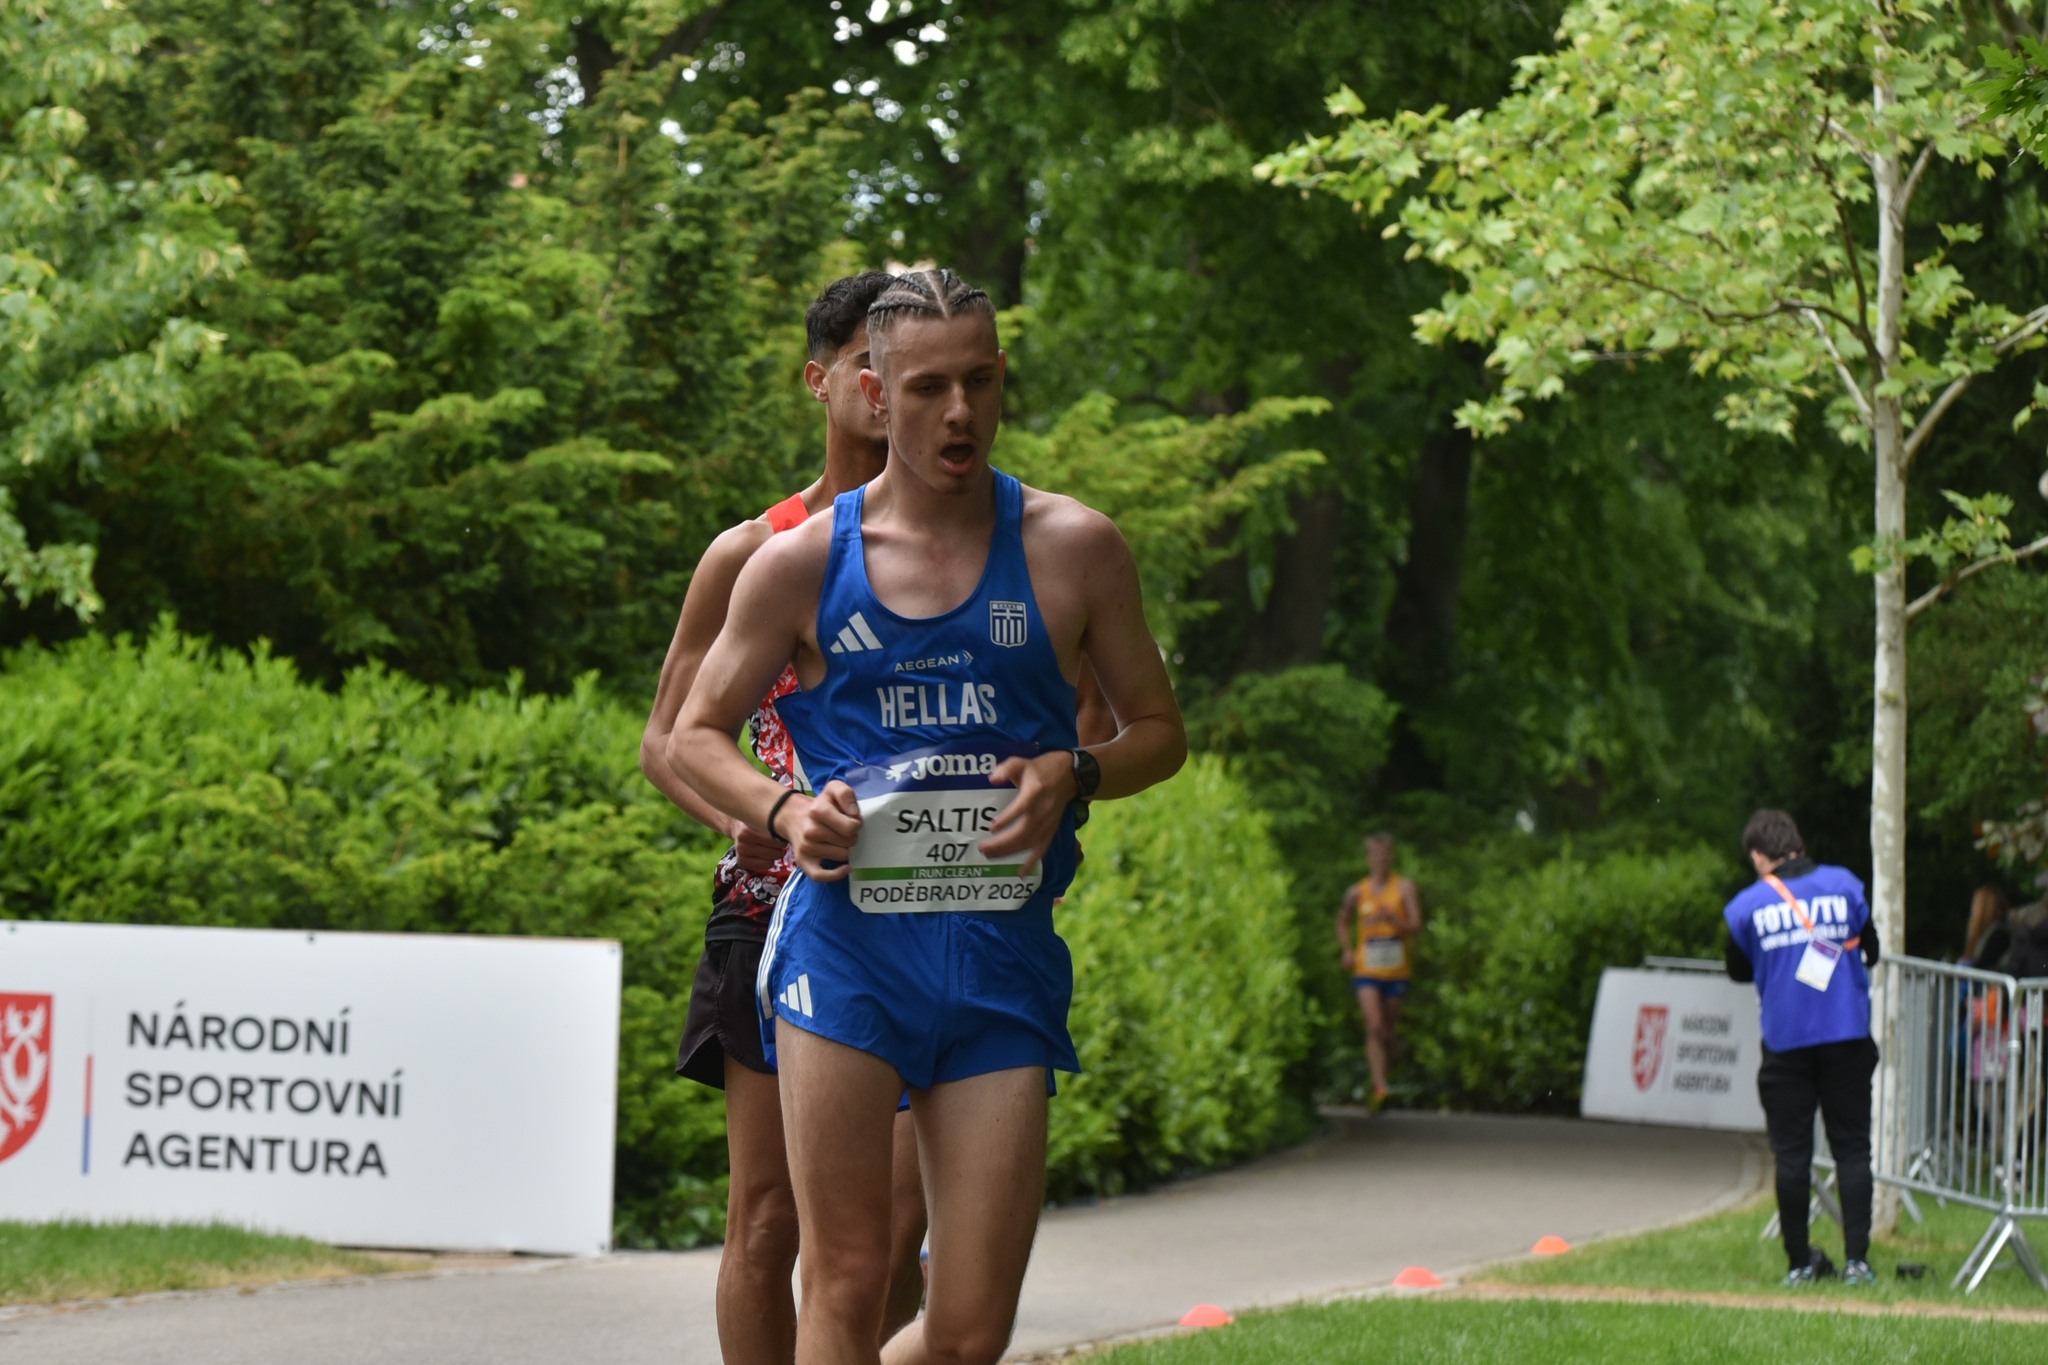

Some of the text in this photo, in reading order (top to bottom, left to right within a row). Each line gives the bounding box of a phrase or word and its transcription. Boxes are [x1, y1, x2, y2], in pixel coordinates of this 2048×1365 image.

[894, 654, 960, 673] AEGEAN
[876, 682, 998, 728] HELLAS
[896, 806, 997, 833] SALTIS
[926, 843, 969, 862] 407
[919, 868, 943, 878] RUN
[859, 881, 1034, 903] PODĚBRADY 2025
[1753, 894, 1848, 937] FOTO/TV
[128, 1000, 351, 1056] NÁRODNÍ
[125, 1069, 403, 1118] SPORTOVNÍ
[123, 1132, 387, 1178] AGENTURA
